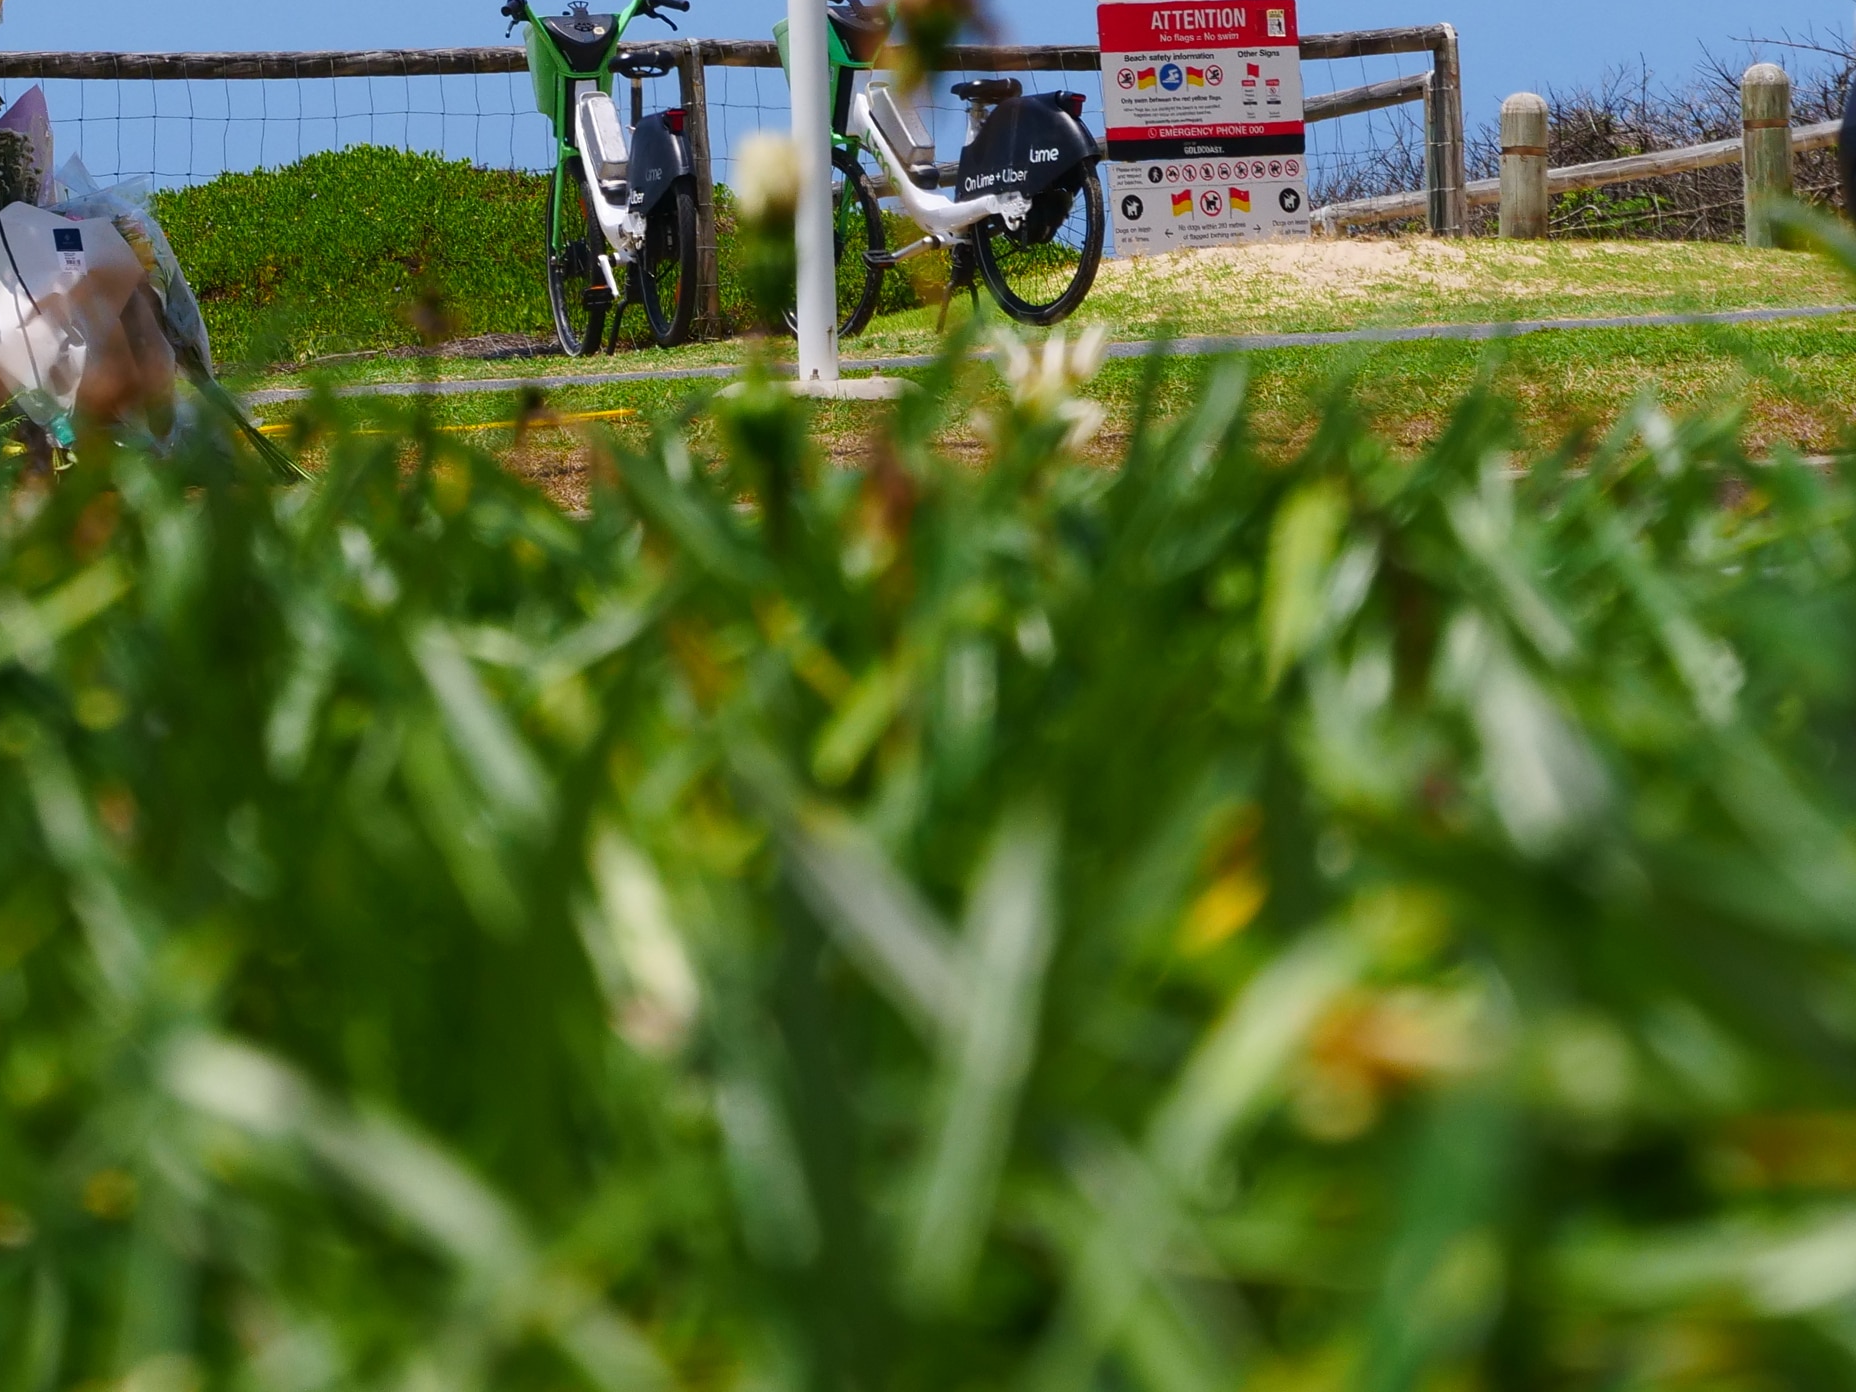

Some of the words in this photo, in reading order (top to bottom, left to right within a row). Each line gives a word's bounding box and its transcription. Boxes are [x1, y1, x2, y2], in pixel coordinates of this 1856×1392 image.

[1151, 7, 1247, 31] ATTENTION
[1159, 33, 1173, 43] No
[1173, 32, 1195, 44] flags
[1203, 32, 1216, 41] No
[1217, 32, 1239, 41] swim
[1124, 54, 1147, 62] Beach
[1149, 53, 1172, 63] safety
[1173, 52, 1215, 62] information
[1237, 50, 1258, 58] Other
[1259, 49, 1280, 58] Signs
[1159, 127, 1214, 138] EMERGENCY
[1215, 125, 1248, 136] PHONE
[1249, 125, 1265, 134] 000
[1029, 145, 1059, 163] Lime
[964, 177, 977, 192] On
[977, 173, 995, 189] Lime
[1002, 168, 1029, 183] Uber
[1115, 227, 1129, 235] Dogs
[1187, 224, 1201, 232] dogs
[1202, 222, 1217, 230] within
[1229, 221, 1246, 229] metres
